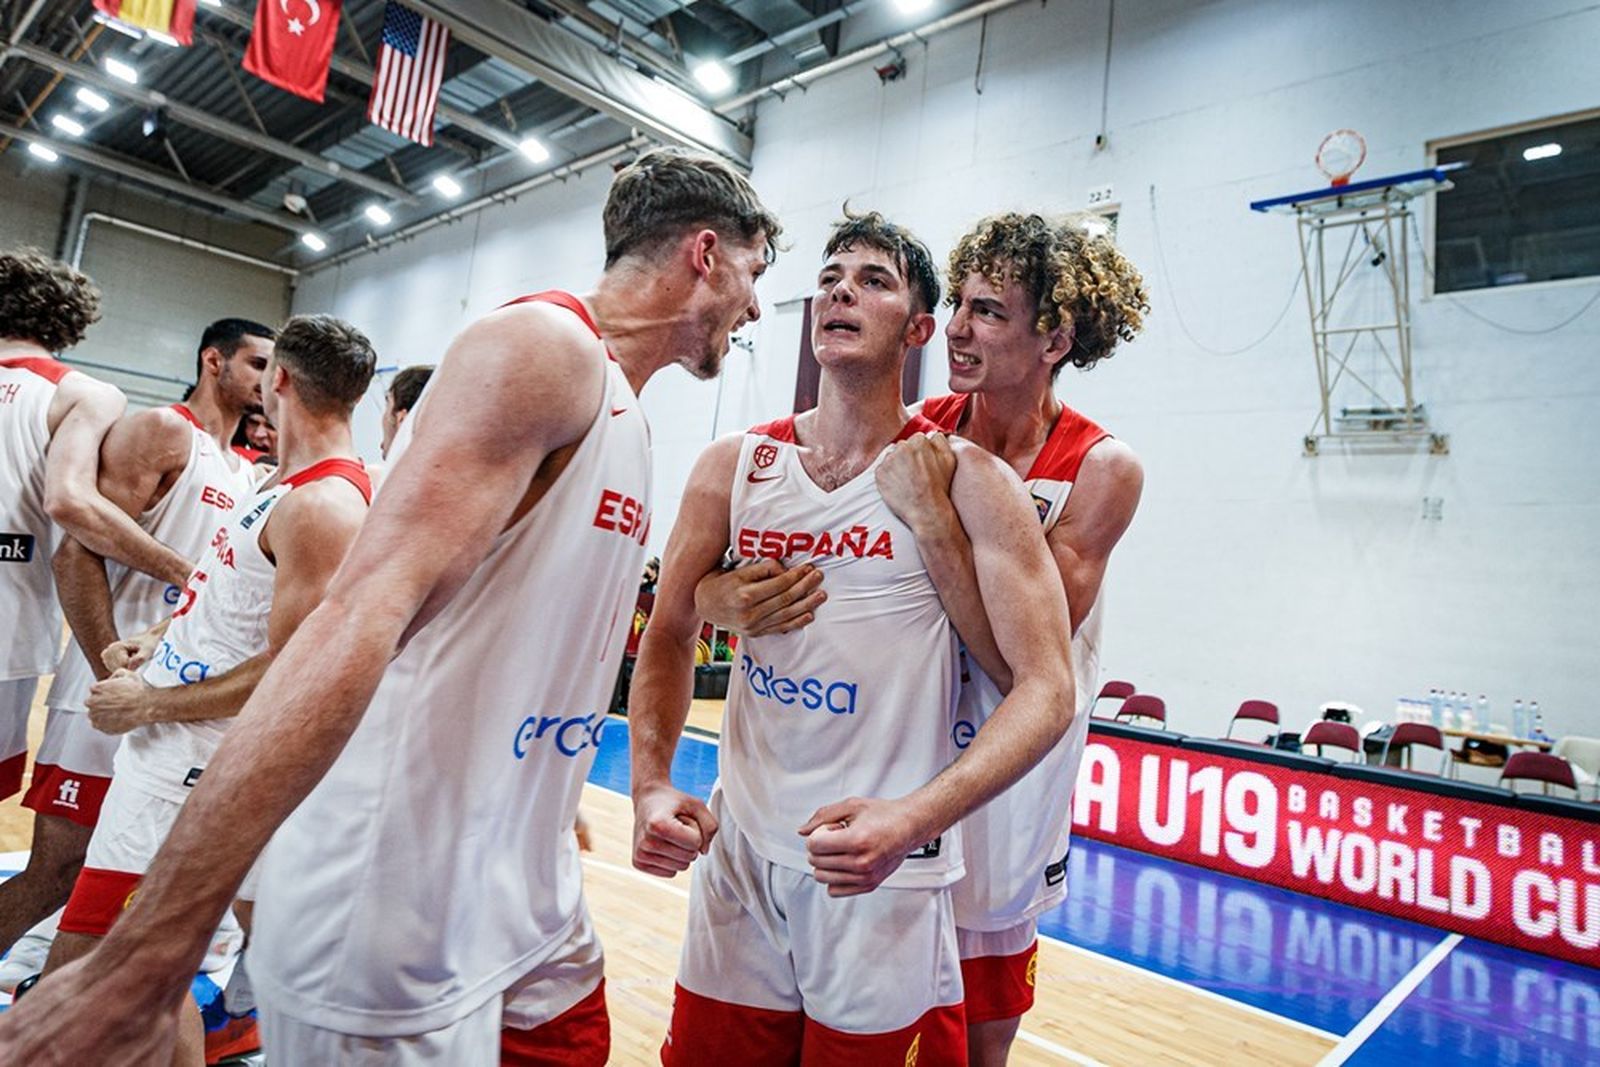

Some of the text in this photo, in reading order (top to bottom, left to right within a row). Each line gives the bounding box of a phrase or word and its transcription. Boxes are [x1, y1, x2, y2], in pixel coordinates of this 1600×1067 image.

[738, 525, 894, 560] ESPAÑA
[1137, 754, 1278, 868] U19
[1288, 784, 1600, 874] BASKETBAL
[1288, 819, 1600, 949] WORLD CU
